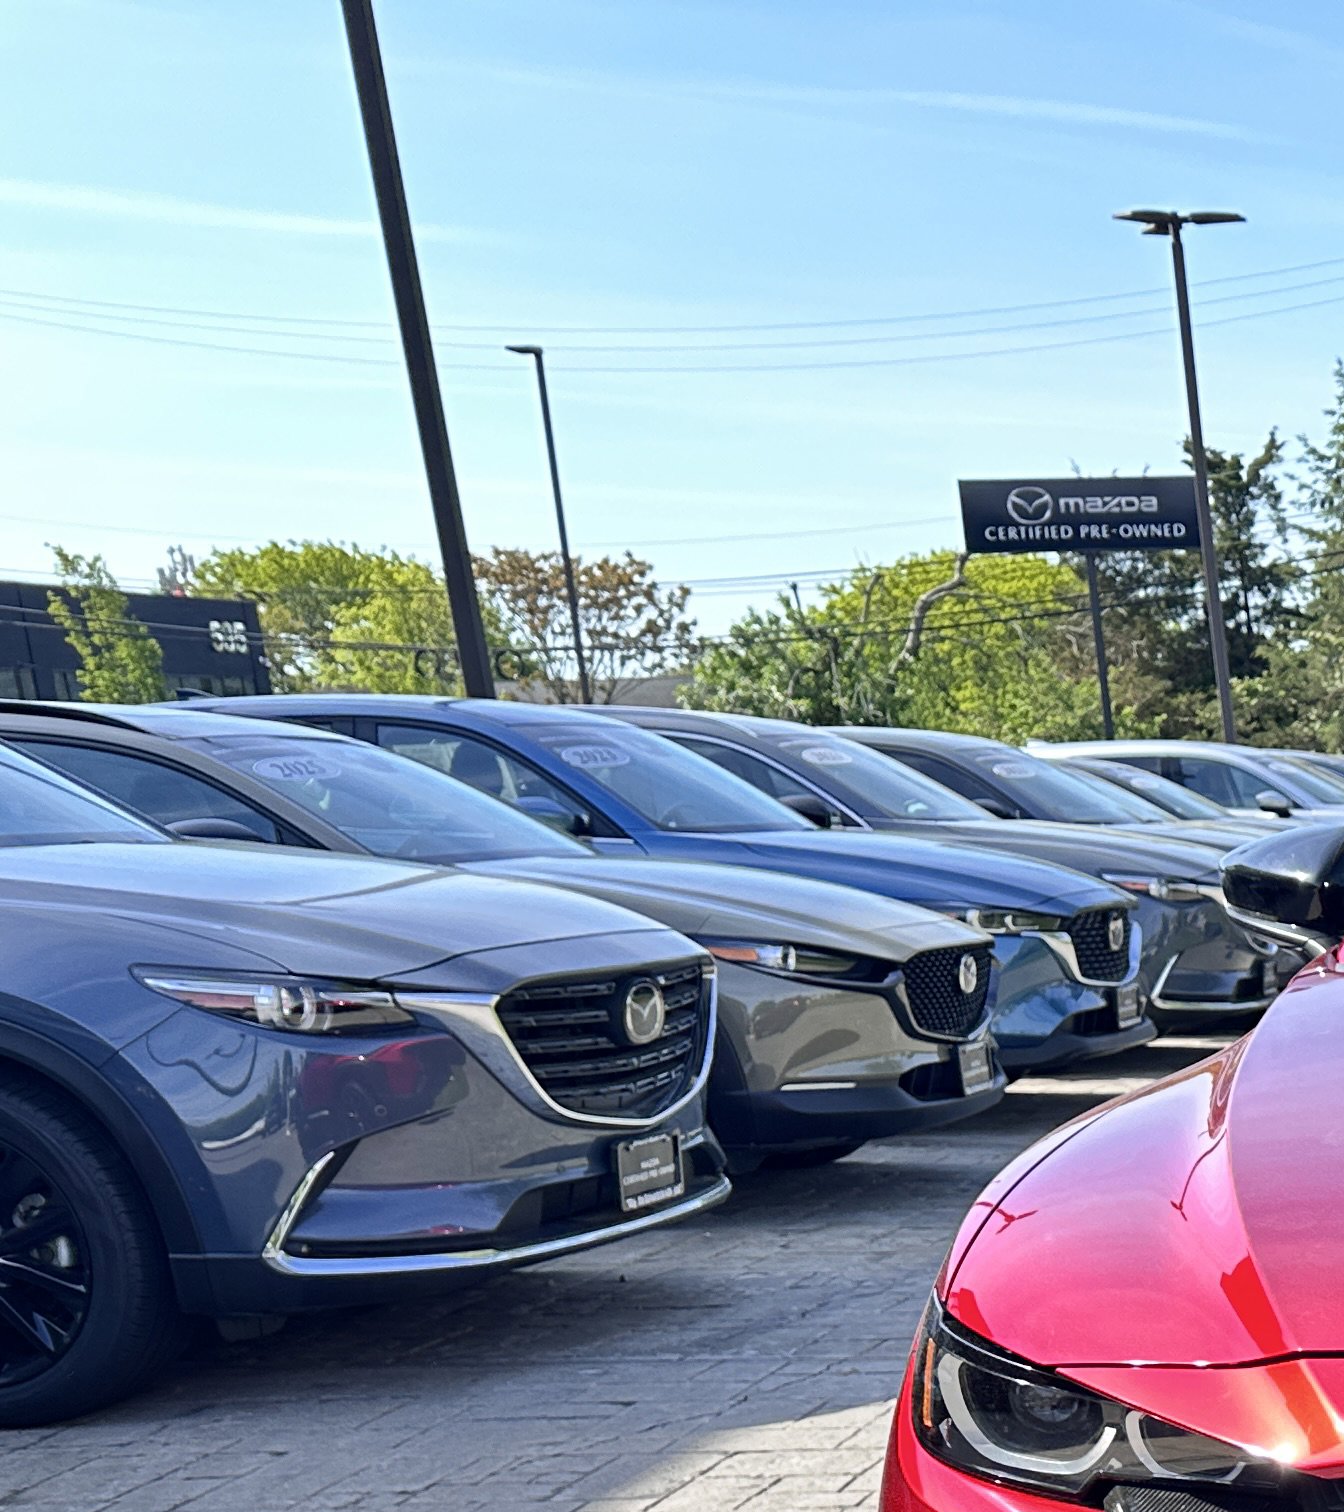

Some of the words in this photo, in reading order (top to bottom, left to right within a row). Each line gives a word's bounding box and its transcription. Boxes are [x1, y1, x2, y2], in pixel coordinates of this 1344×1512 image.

[1058, 495, 1159, 514] mazda
[984, 523, 1074, 542] CERTIFIED
[1080, 522, 1187, 539] PRE-OWNED
